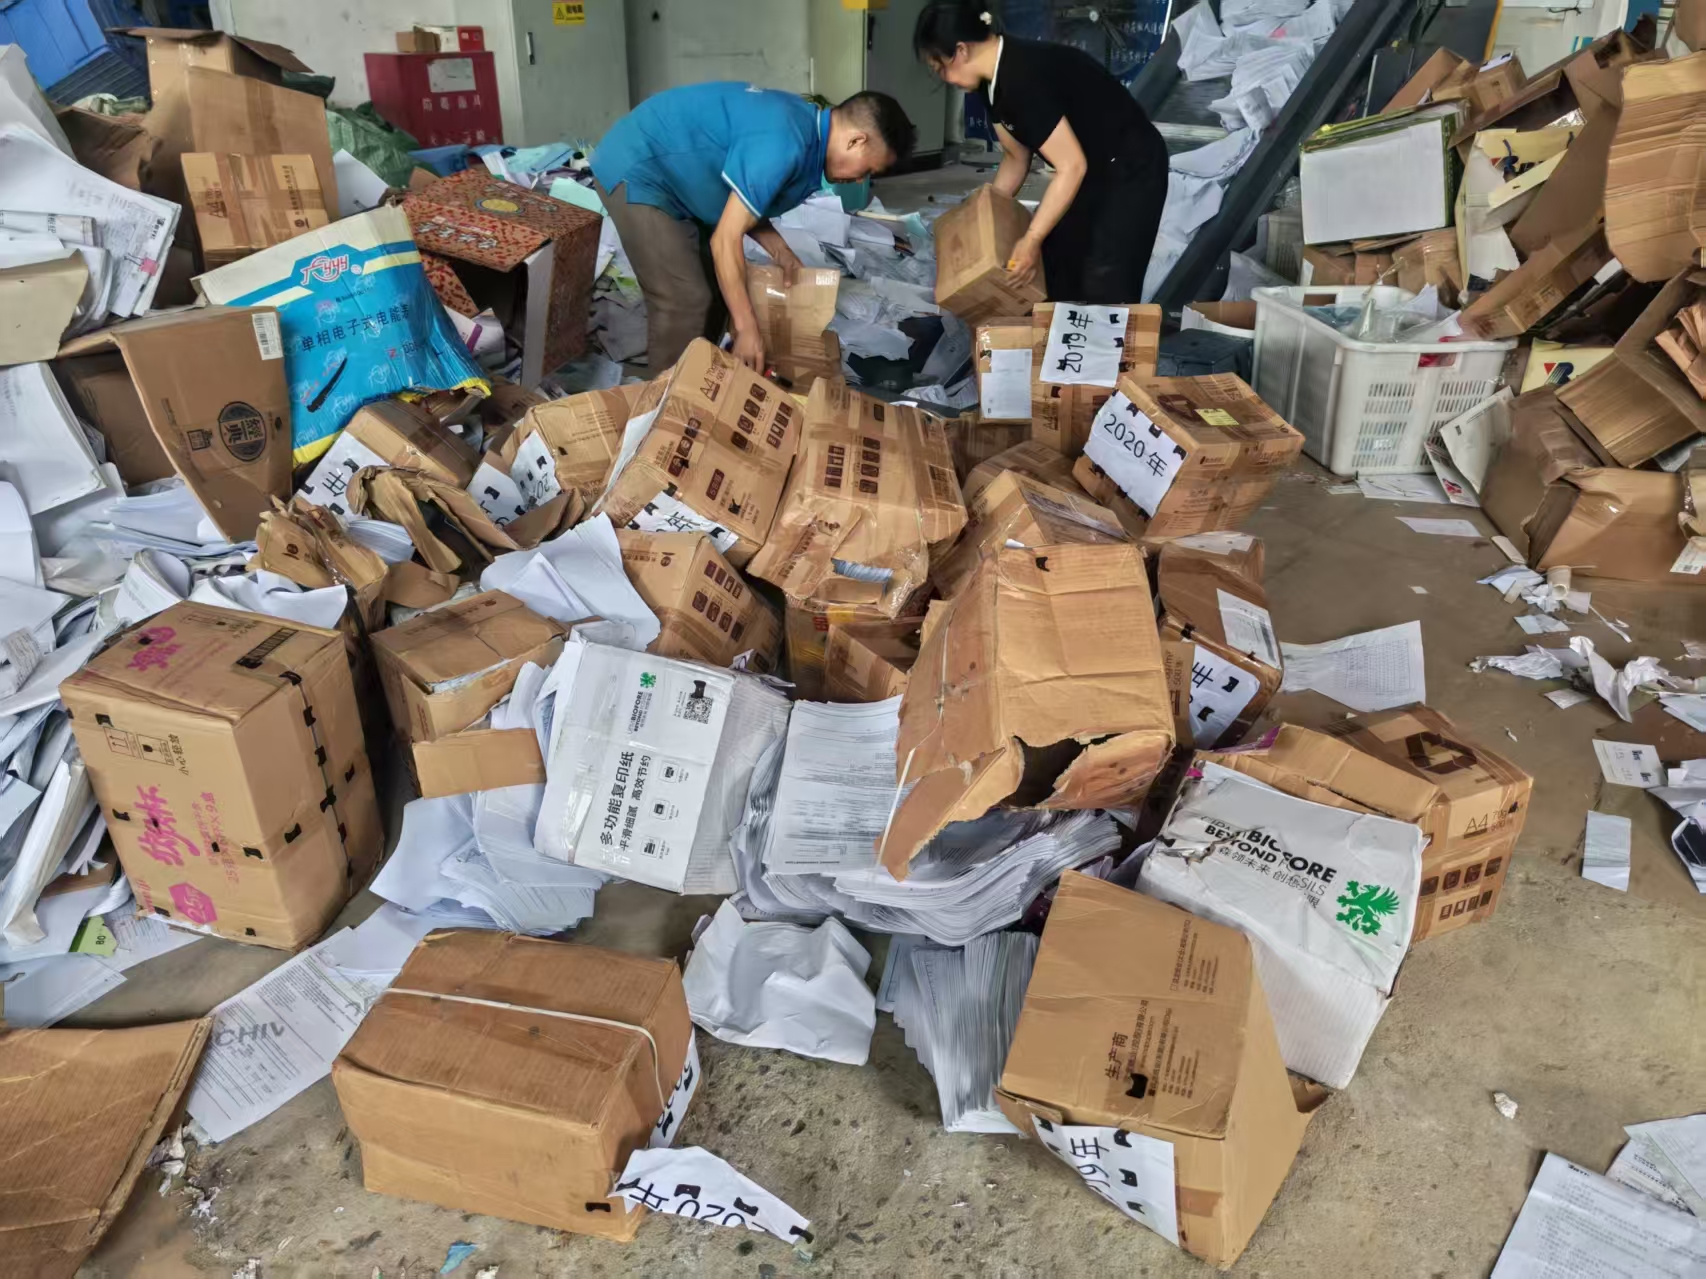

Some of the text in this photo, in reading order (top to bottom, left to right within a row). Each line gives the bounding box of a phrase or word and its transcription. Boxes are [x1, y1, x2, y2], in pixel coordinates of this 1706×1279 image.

[1104, 414, 1168, 477] 2020年
[600, 751, 634, 846] 多功能复印纸
[619, 755, 651, 851] 平滑细腻 高效节约
[1465, 814, 1489, 833] A4
[1220, 846, 1272, 876] 森领未来
[1105, 1032, 1128, 1081] 生产商
